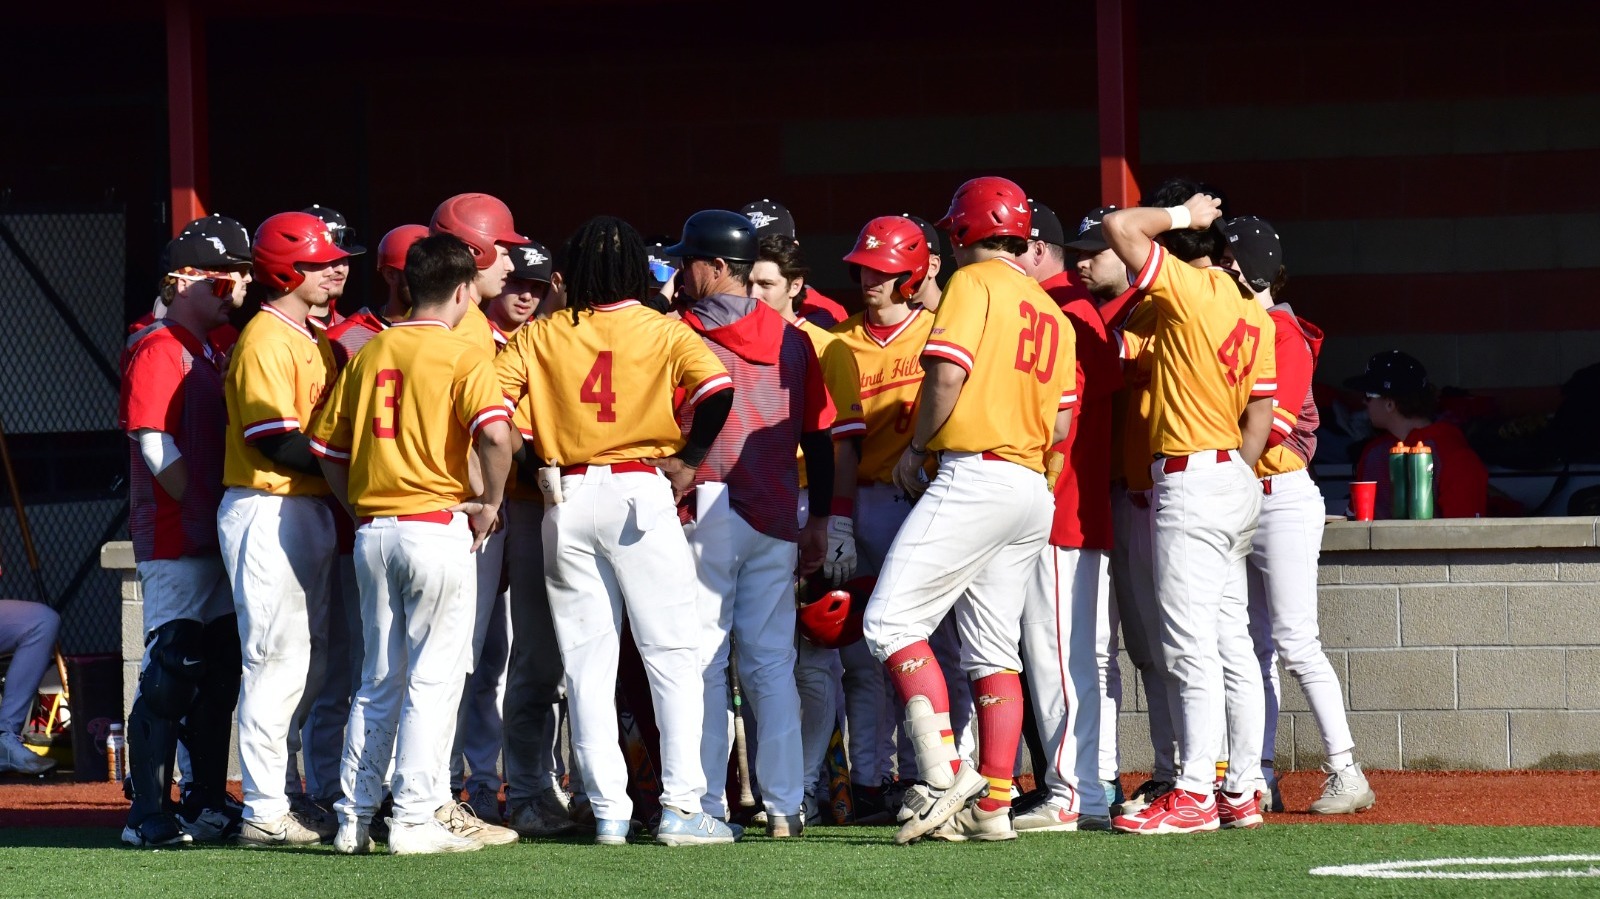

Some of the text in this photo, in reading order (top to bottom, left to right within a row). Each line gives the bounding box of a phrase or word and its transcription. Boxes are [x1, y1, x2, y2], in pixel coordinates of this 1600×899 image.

[891, 354, 924, 379] Hill
[1014, 300, 1059, 384] 20
[1217, 317, 1260, 389] 47
[372, 368, 404, 439] 3
[580, 351, 616, 423] 4
